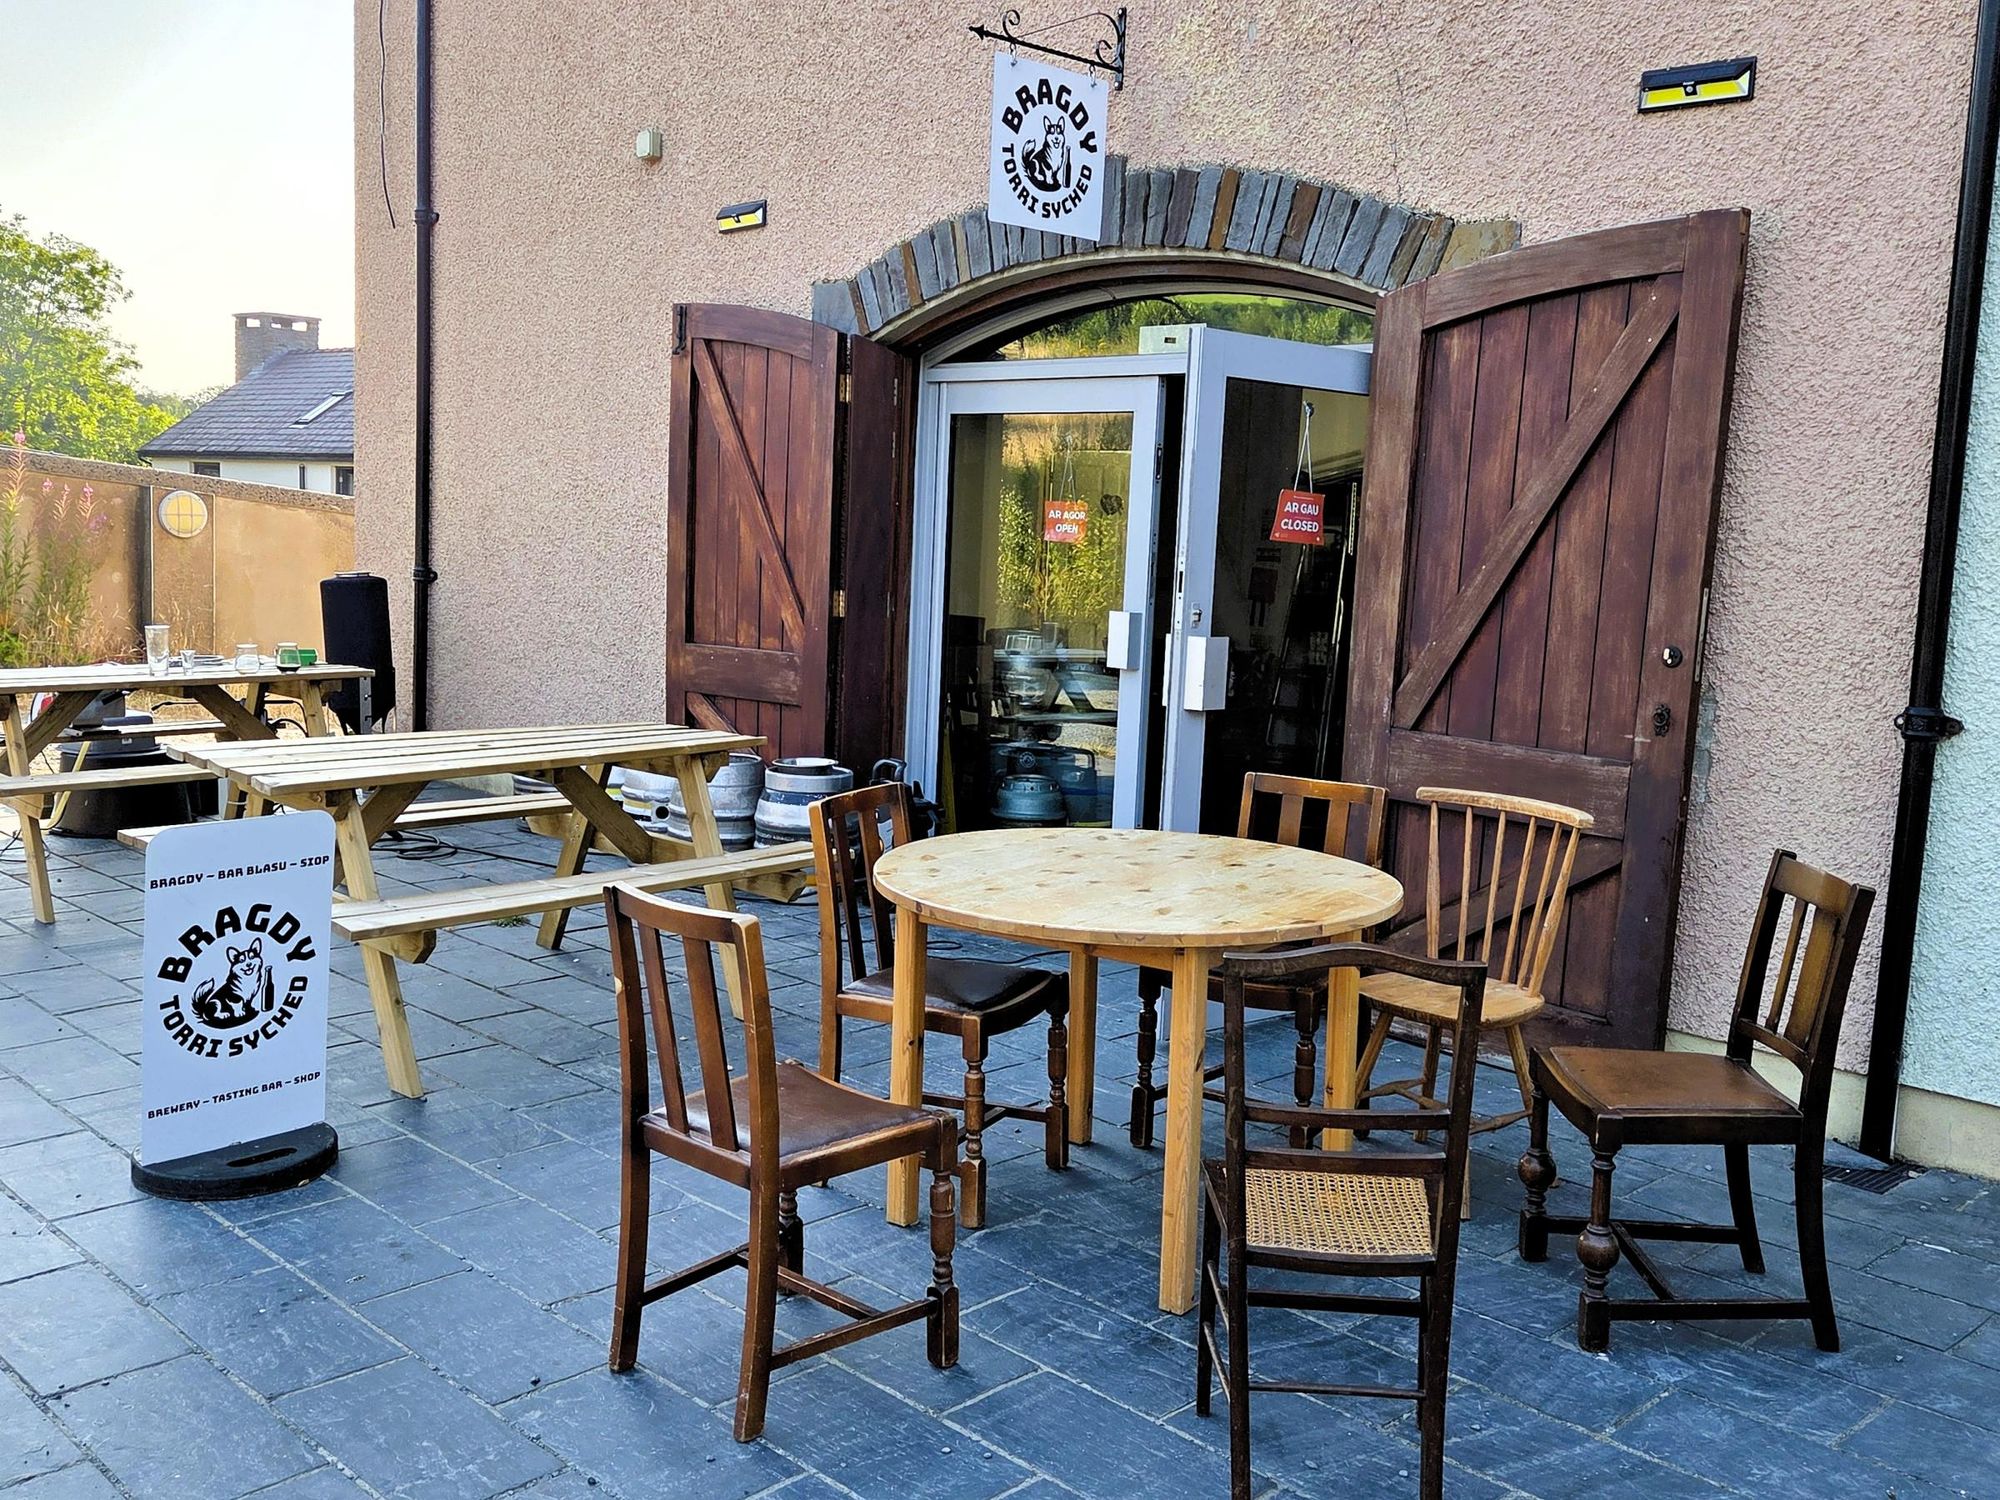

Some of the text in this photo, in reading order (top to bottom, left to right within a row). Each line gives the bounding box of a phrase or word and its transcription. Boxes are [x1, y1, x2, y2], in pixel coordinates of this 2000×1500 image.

[1001, 78, 1098, 154] BRAGDY
[1001, 143, 1092, 219] TORRI SYCHED
[1048, 510, 1086, 520] AR AGOR
[1055, 523, 1079, 534] OPEN
[1280, 518, 1319, 532] CLOSED
[1284, 501, 1319, 516] AR GAU
[150, 873, 204, 890] BRAGDY
[217, 869, 244, 880] BAR
[246, 861, 287, 876] BLASU
[300, 855, 330, 868] SIOP
[157, 903, 317, 983] BRAGDY
[159, 976, 308, 1058] TORRI SYCHED
[147, 1099, 201, 1119] BREWERY
[211, 1086, 259, 1104] TASTING
[261, 1080, 283, 1092] BAR
[293, 1071, 321, 1085] SHOP
